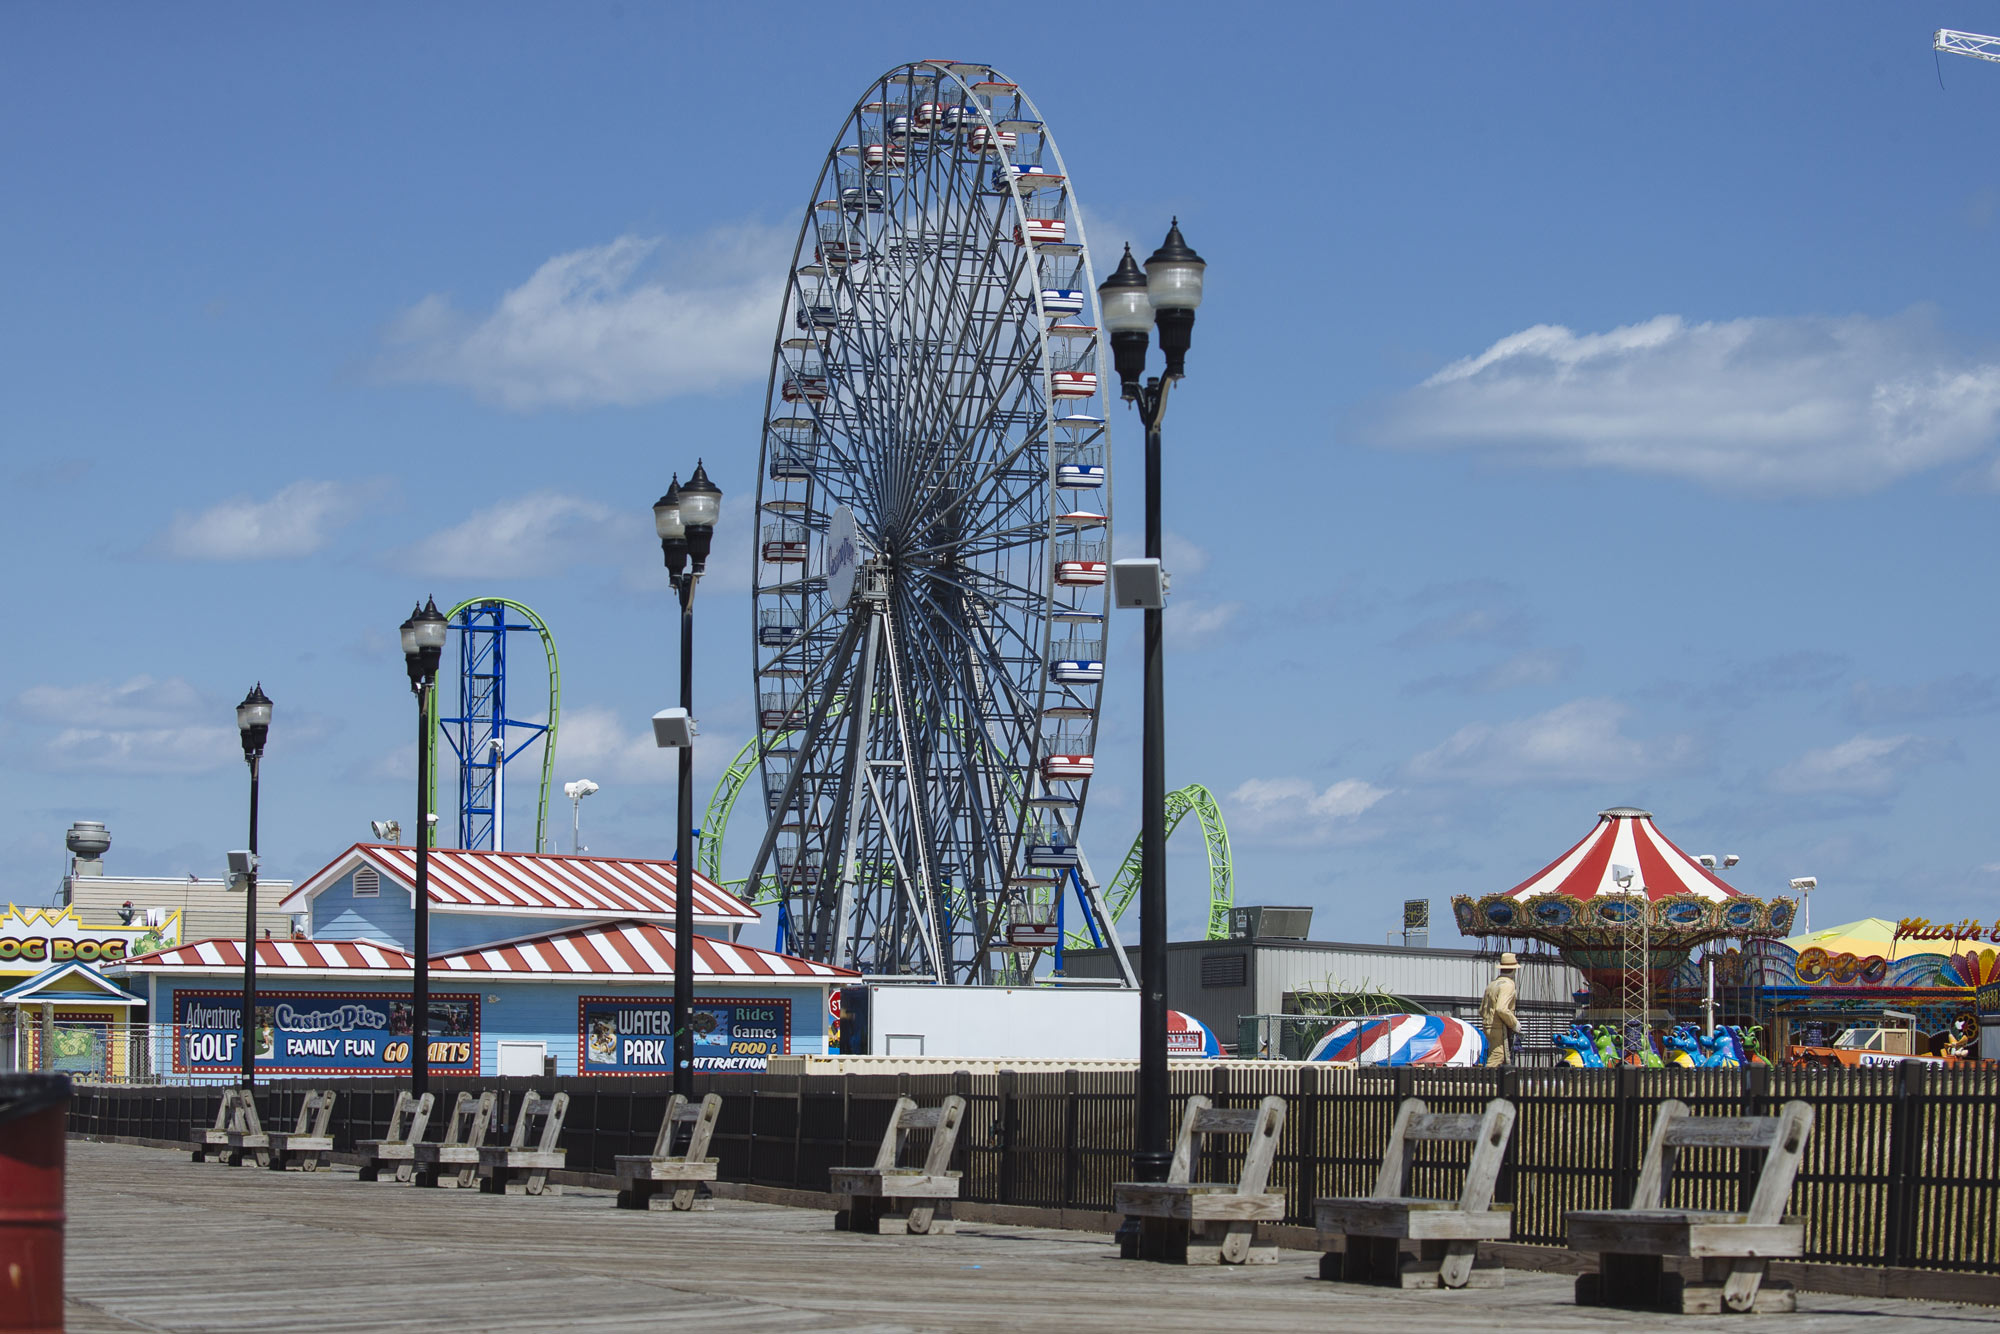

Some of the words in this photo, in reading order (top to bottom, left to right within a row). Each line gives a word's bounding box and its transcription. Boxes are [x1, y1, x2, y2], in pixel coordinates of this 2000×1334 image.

[1893, 917, 1981, 941] Musik
[51, 938, 128, 963] BOG
[186, 1002, 242, 1029] Adventure
[618, 1010, 671, 1035] WATER
[735, 1008, 775, 1021] Rides
[732, 1025, 777, 1039] Games
[190, 1033, 239, 1061] GOLF
[287, 1039, 340, 1057] FAMILY
[344, 1039, 376, 1057] FUN
[383, 1042, 409, 1062] GO
[624, 1039, 666, 1065] PARK
[730, 1042, 767, 1055] FOOD
